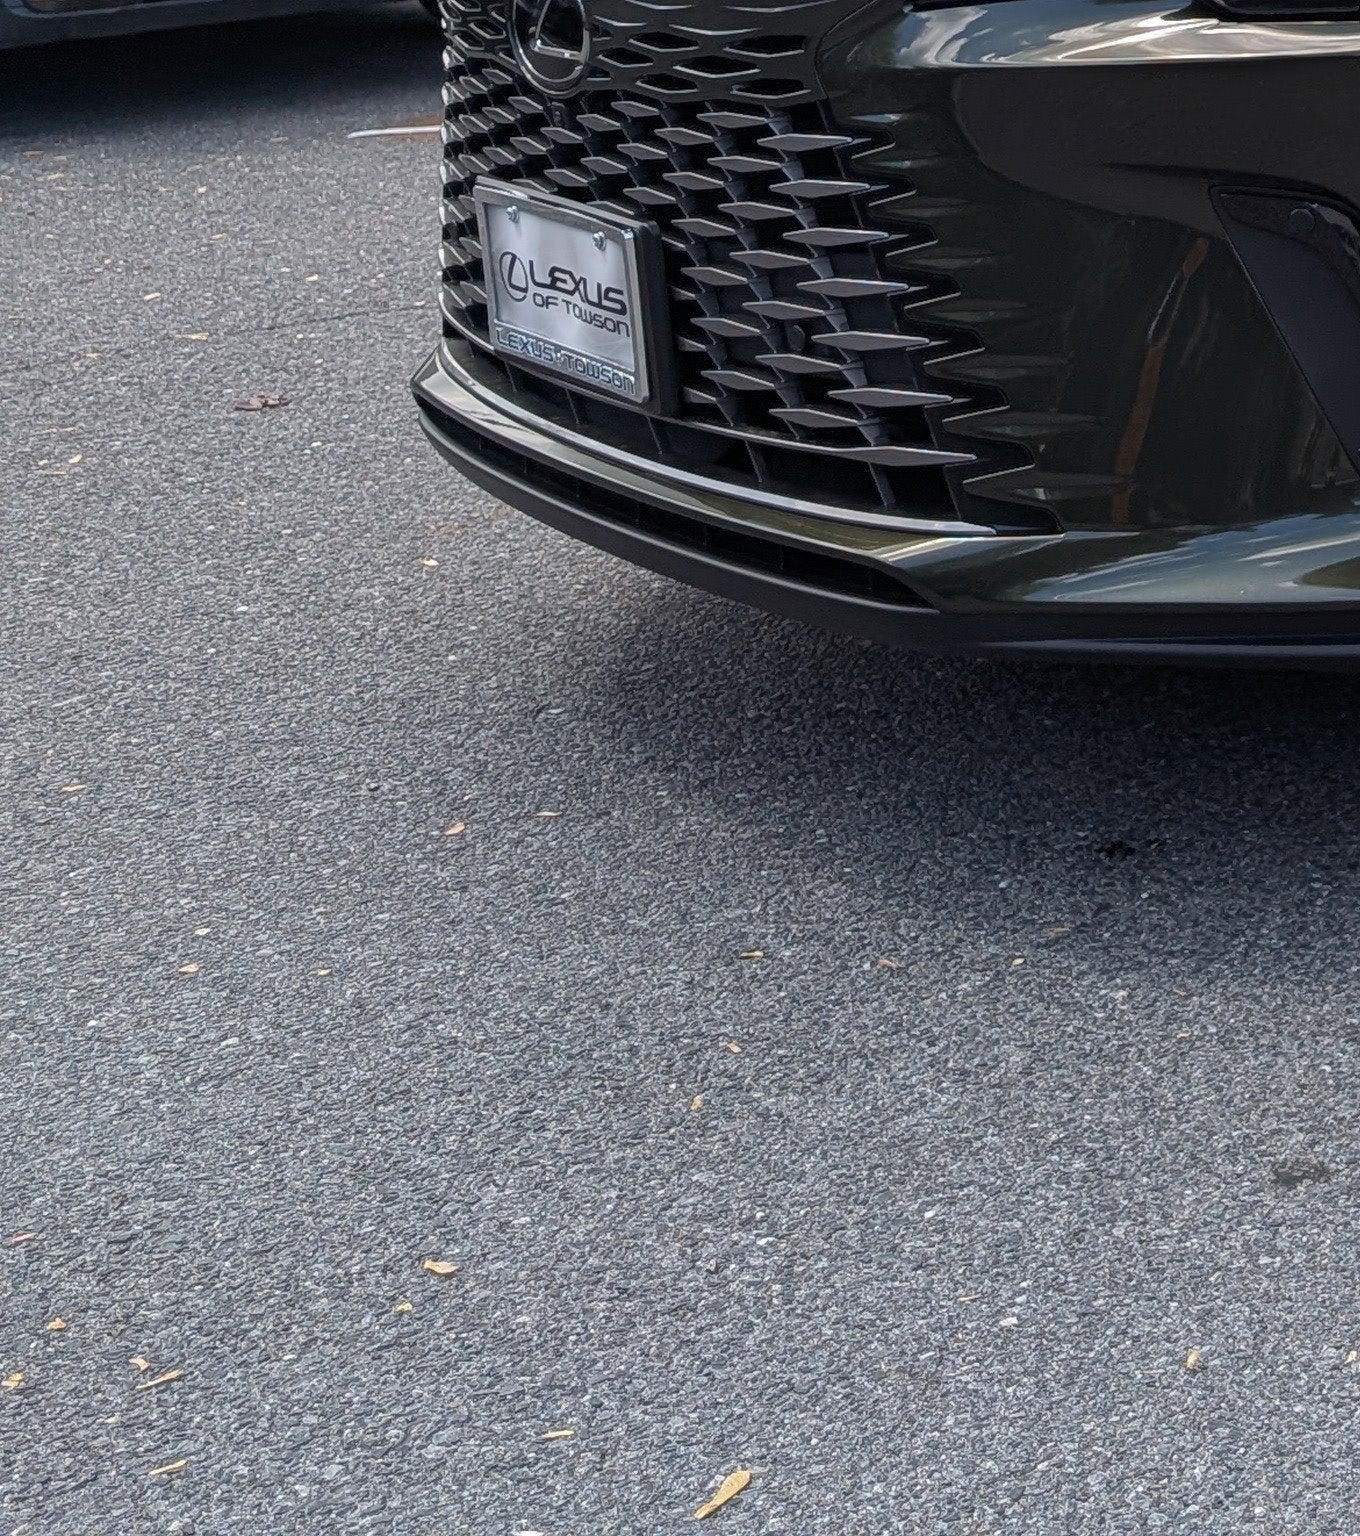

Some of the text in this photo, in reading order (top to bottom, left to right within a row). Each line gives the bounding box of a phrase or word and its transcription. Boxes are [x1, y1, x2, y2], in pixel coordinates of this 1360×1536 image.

[528, 260, 628, 316] LEXUS
[533, 293, 559, 310] OF
[496, 327, 556, 362] LEXUS
